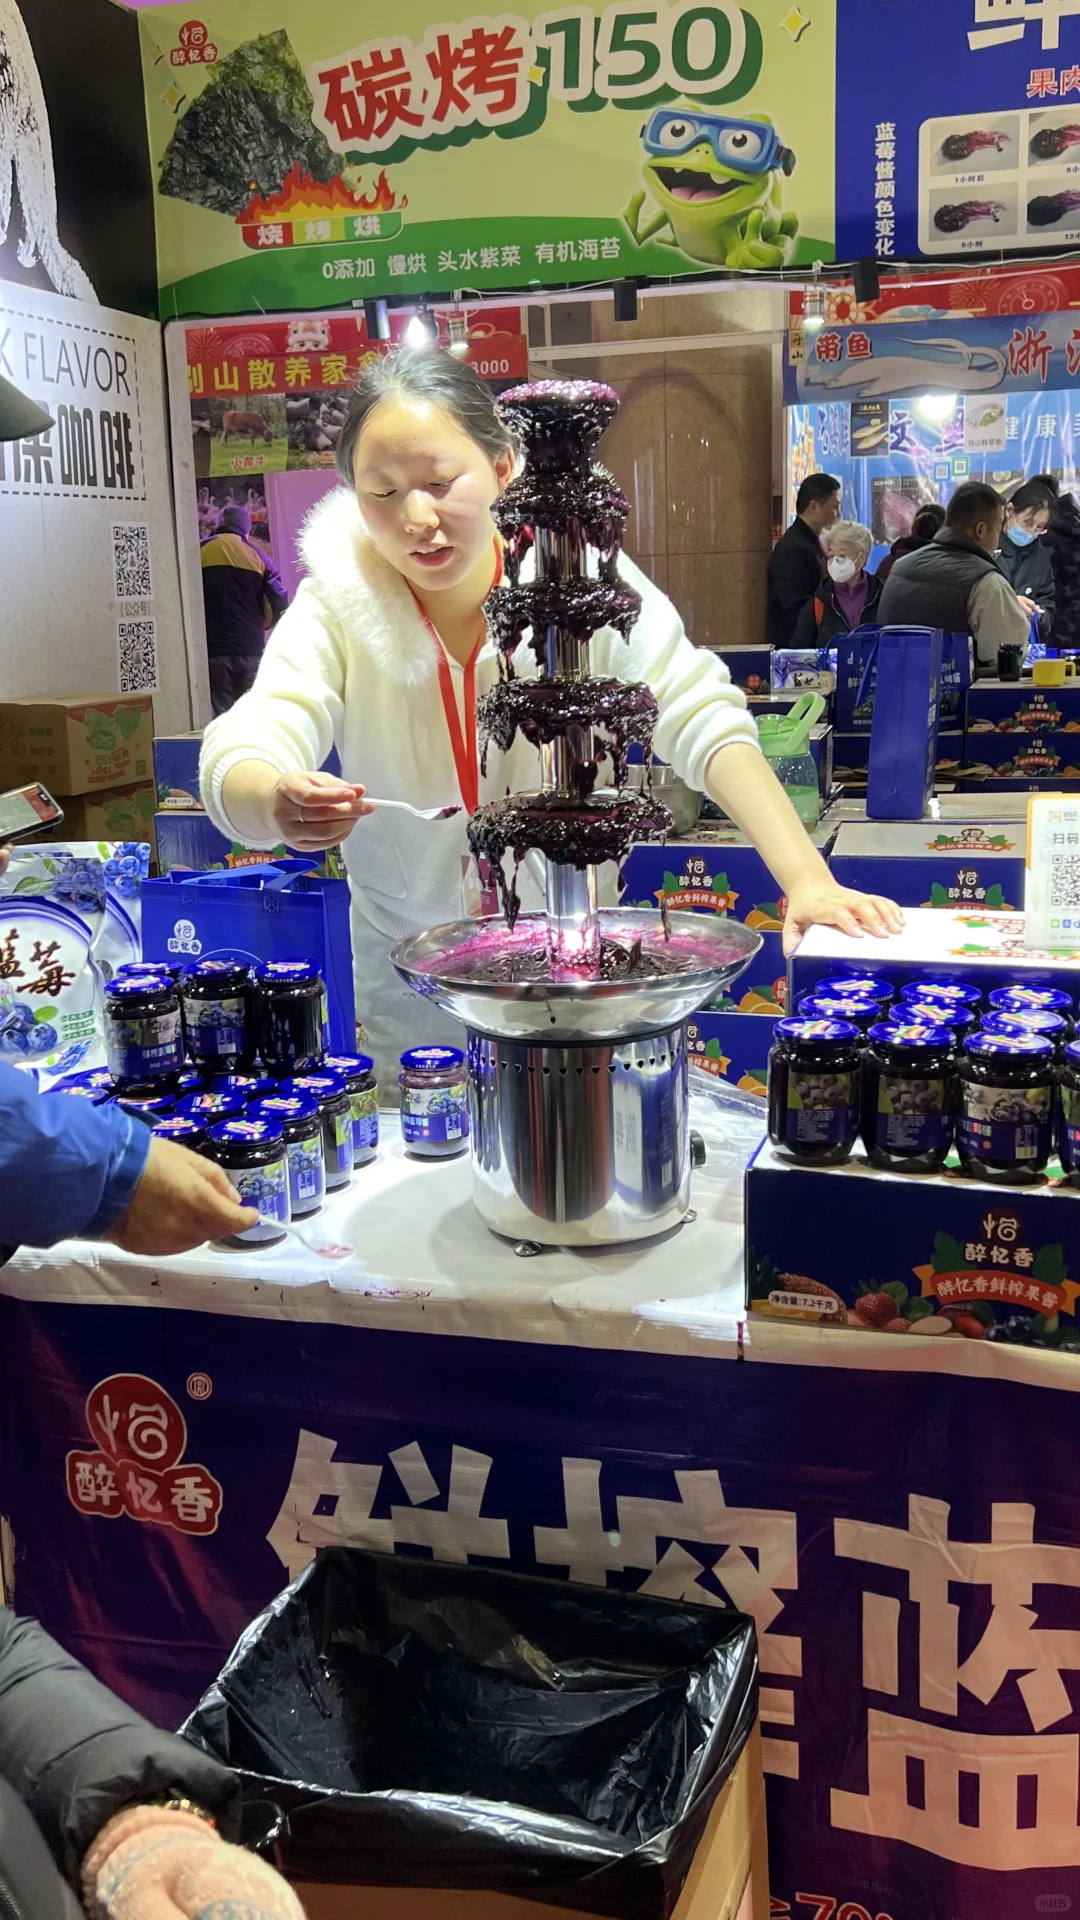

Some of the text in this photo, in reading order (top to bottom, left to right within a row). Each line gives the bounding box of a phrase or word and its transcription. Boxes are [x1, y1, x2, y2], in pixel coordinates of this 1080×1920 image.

[172, 46, 217, 64] 醉忆香
[318, 6, 732, 141] 碳烤 150
[874, 122, 896, 256] 蓝莓酱颜色变化
[323, 237, 621, 279] 0添加 慢烘 头水紫菜 有机海苔
[816, 332, 872, 361] 带鱼
[24, 331, 131, 396] FLAVOR
[231, 456, 267, 469] 小黄牛
[1052, 832, 1079, 844] 扫码
[679, 875, 714, 887] 醉忆香
[948, 888, 986, 899] 醉忆香
[169, 940, 200, 953] 醉忆香
[965, 1243, 1034, 1267] 醉忆香
[936, 1275, 1059, 1309] 醉忆香鲜榨果酱
[75, 1461, 213, 1524] 醉忆香
